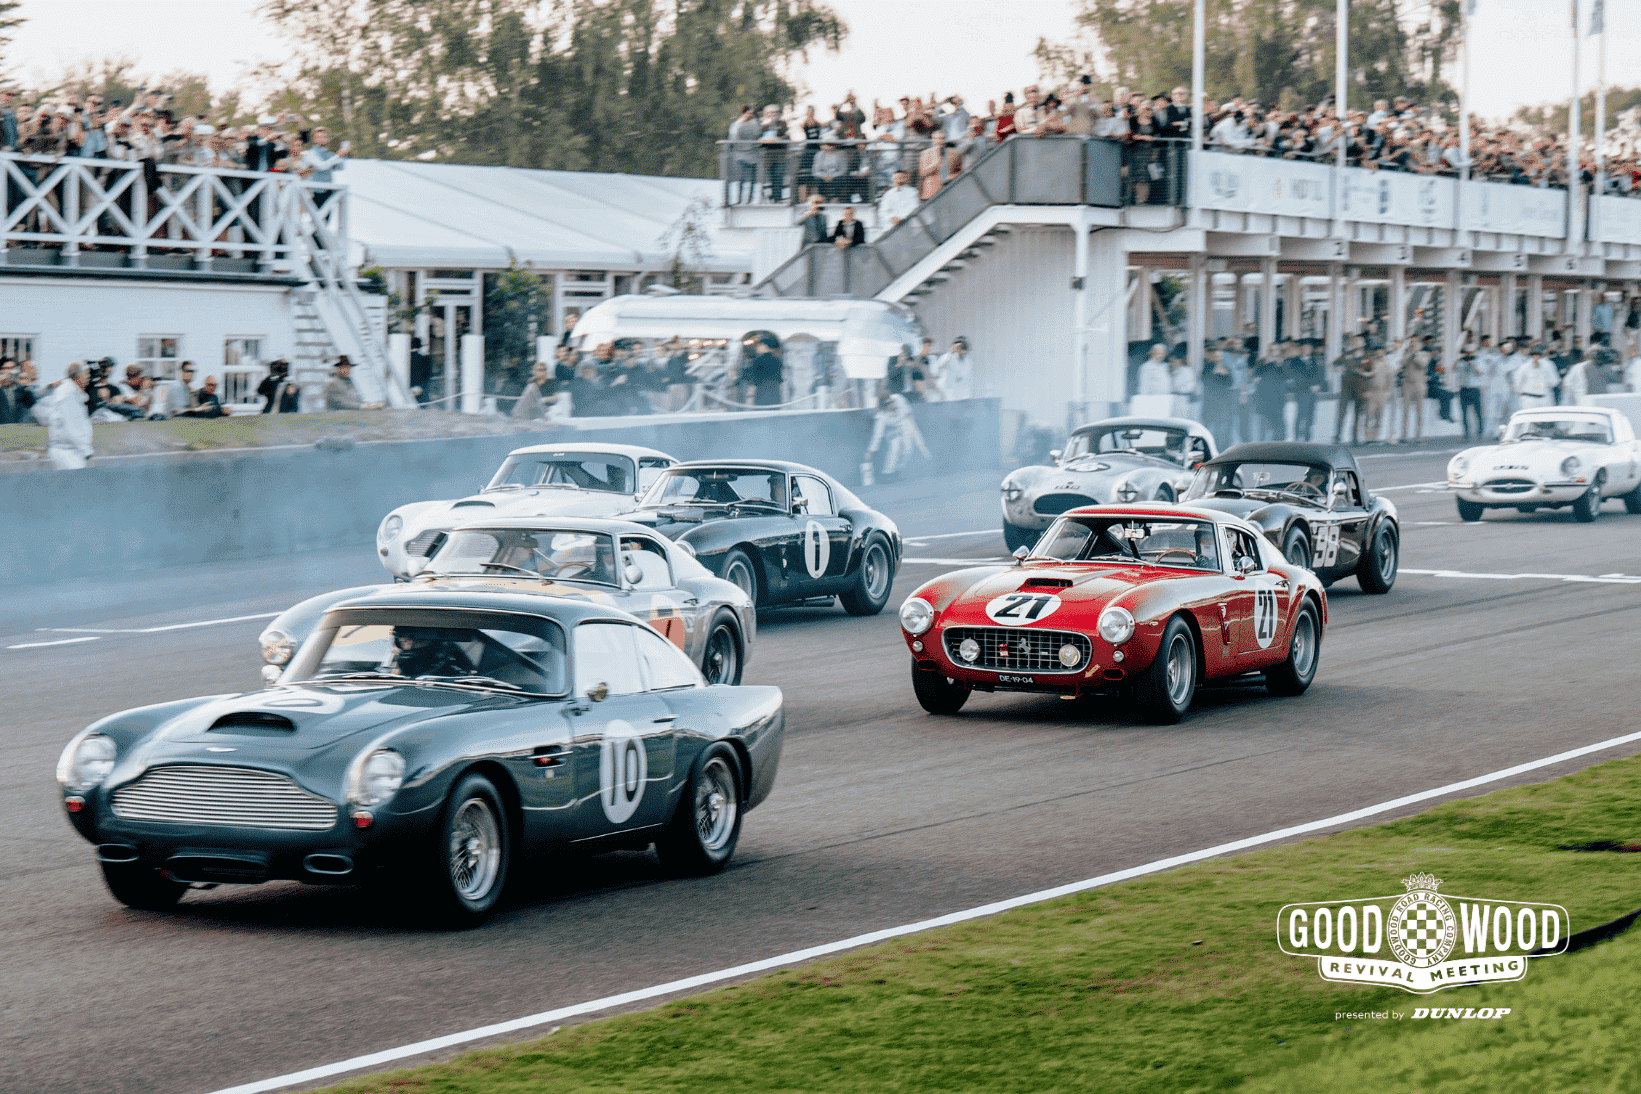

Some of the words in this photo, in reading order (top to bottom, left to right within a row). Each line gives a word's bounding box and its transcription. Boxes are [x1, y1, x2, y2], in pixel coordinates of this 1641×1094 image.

[993, 594, 1053, 620] 21
[1257, 589, 1274, 639] 21
[608, 739, 639, 806] 10
